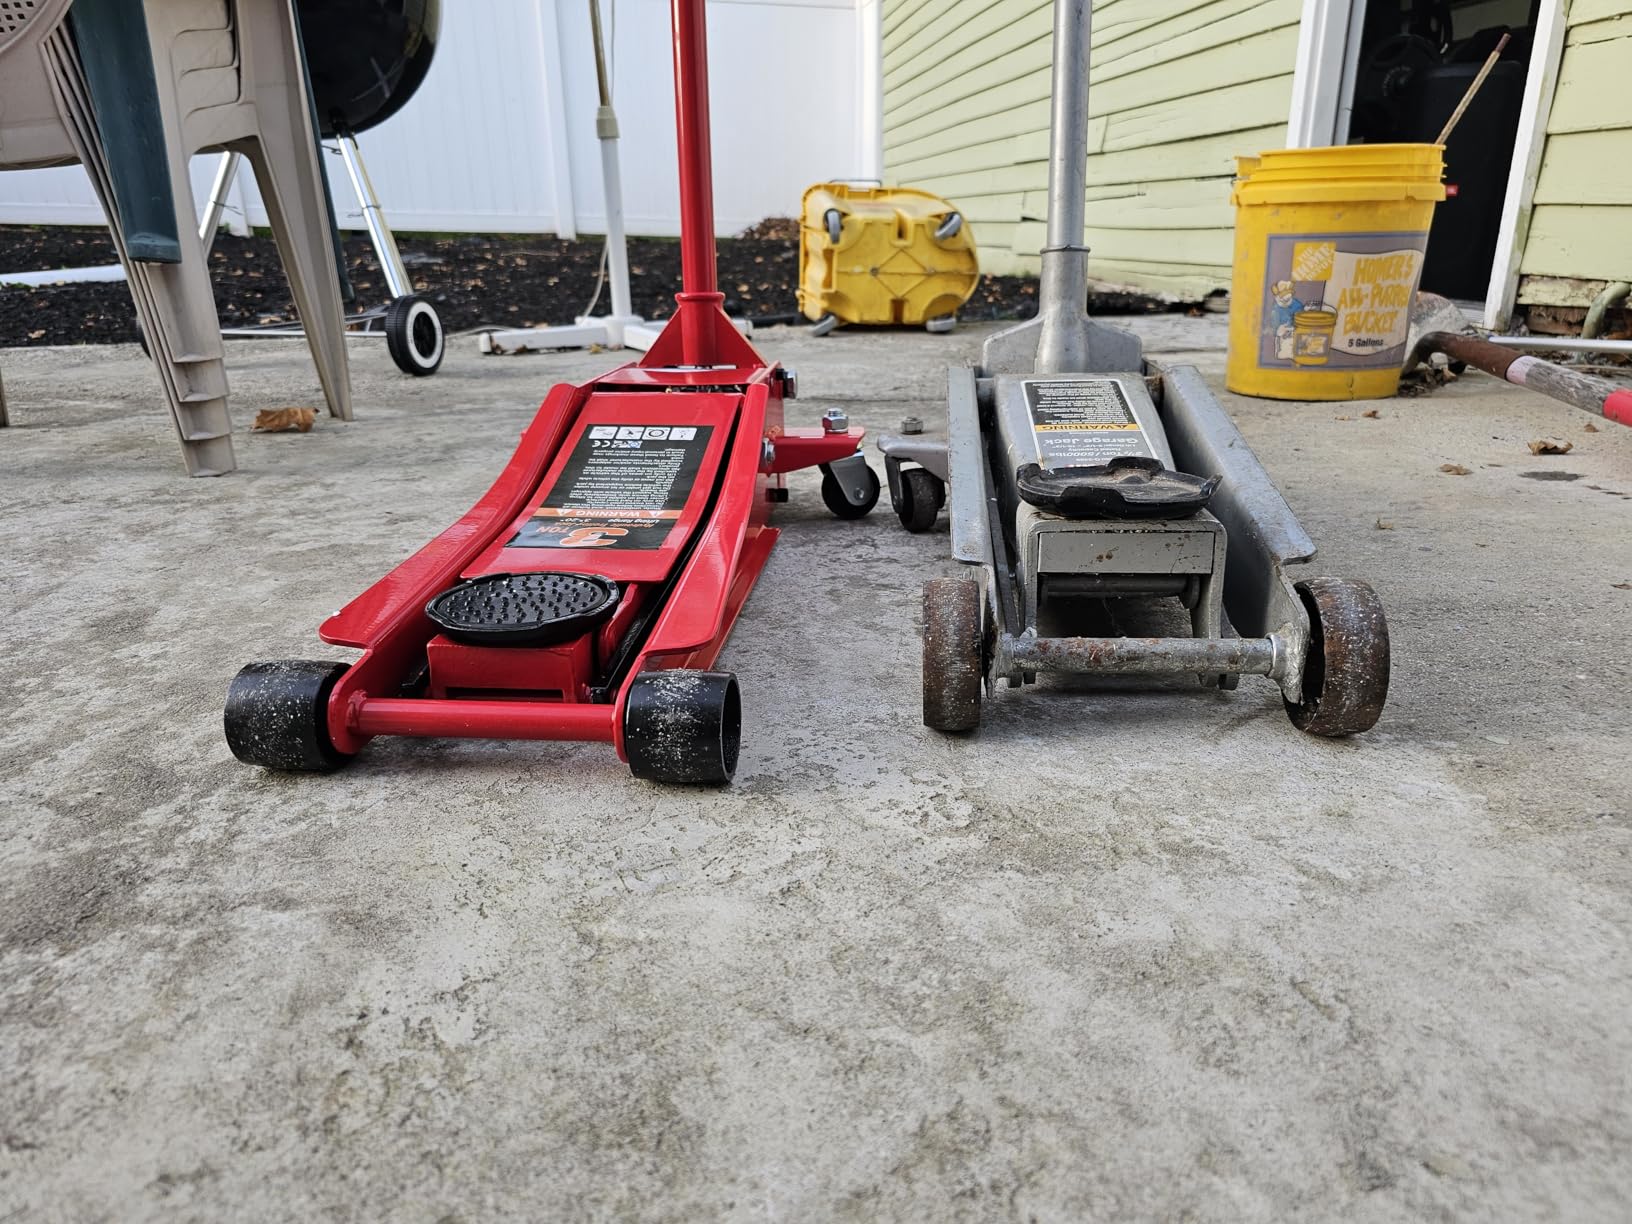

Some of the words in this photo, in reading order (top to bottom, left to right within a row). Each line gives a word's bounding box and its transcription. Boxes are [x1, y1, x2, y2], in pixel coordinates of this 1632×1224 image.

[1291, 243, 1330, 281] HOME
[1343, 310, 1399, 336] BUCKET
[1348, 338, 1354, 347] 5
[1355, 338, 1384, 347] Gallons
[559, 527, 628, 547] 3
